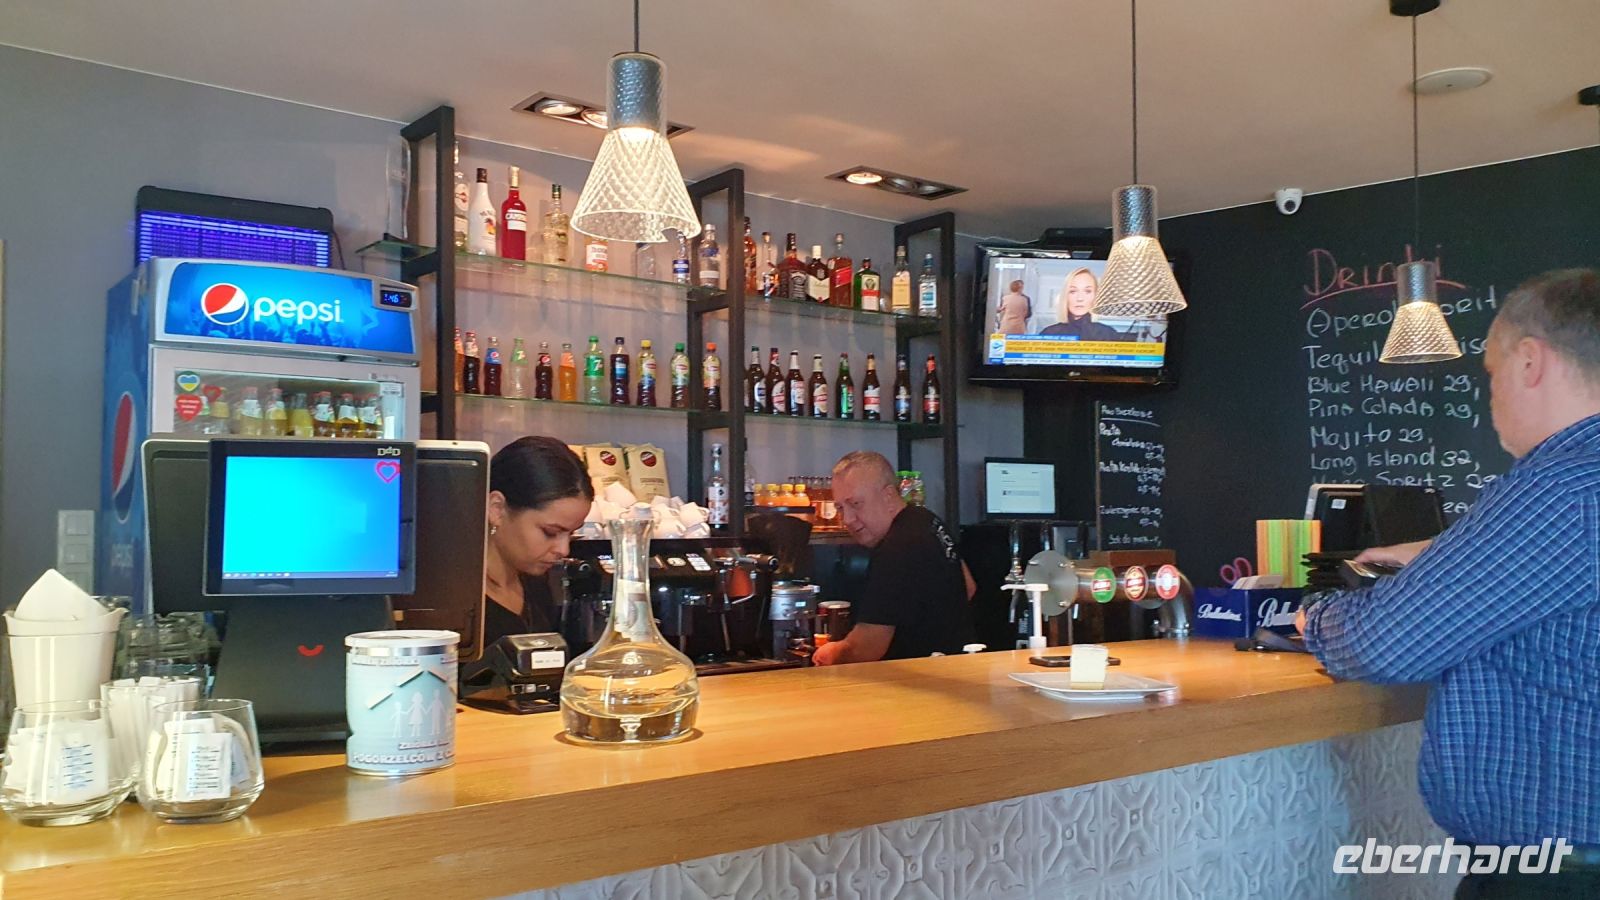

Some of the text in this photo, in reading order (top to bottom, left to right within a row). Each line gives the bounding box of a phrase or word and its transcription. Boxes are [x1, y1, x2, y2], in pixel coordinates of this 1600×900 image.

[253, 296, 342, 325] pepsi
[1307, 376, 1351, 395] Blue
[1310, 453, 1357, 476] Long
